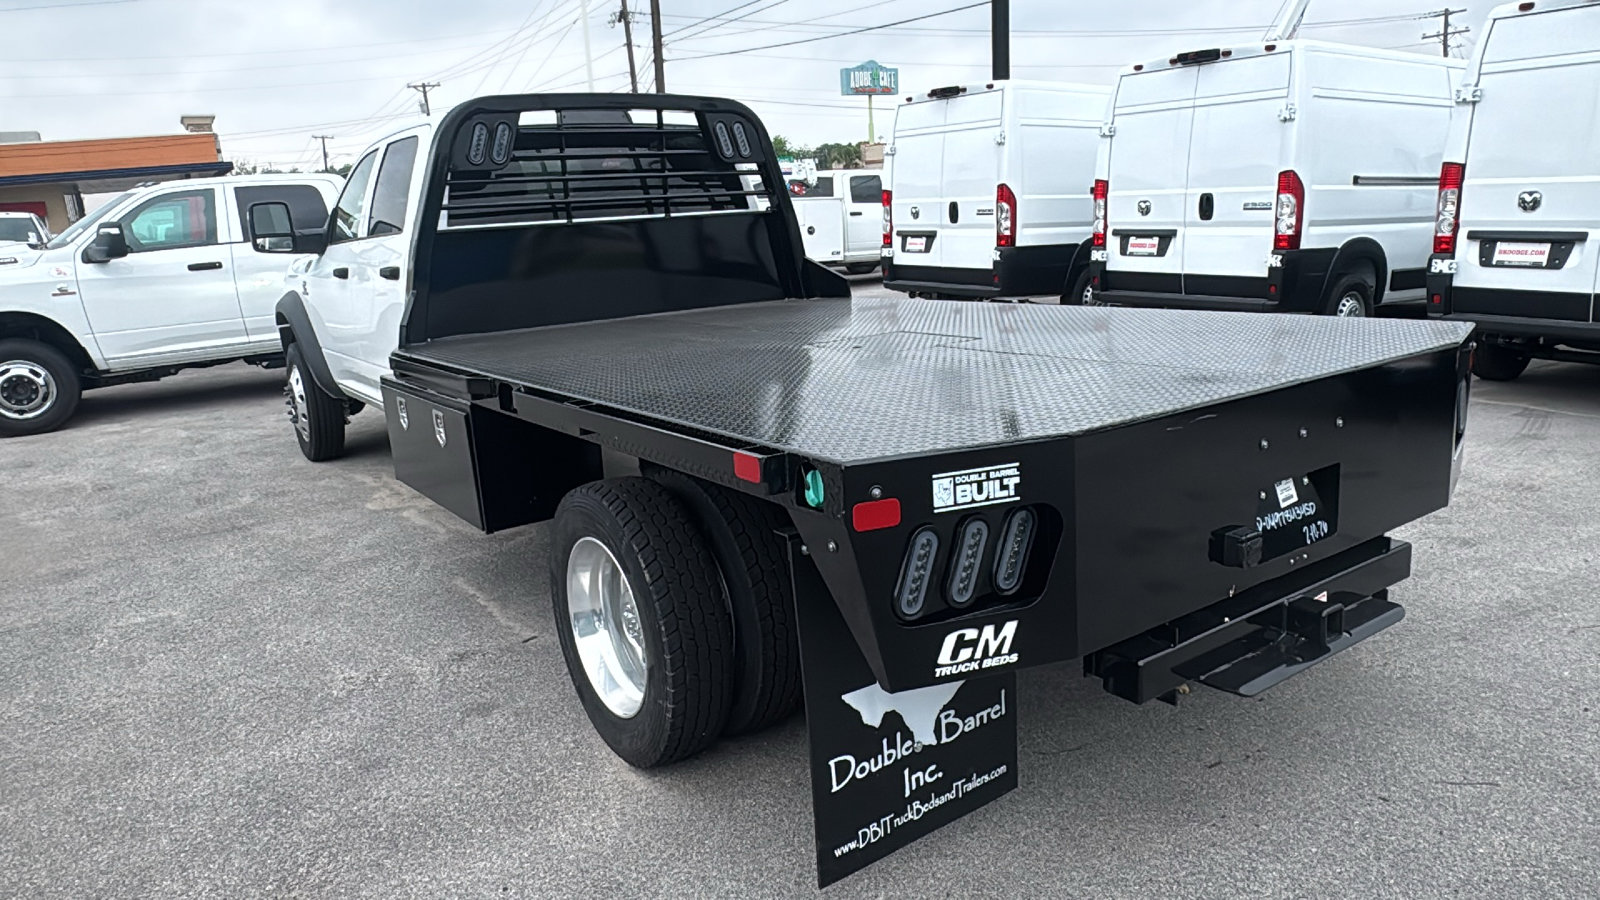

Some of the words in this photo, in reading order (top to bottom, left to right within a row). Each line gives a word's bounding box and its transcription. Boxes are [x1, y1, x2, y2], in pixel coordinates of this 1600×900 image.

[850, 71, 872, 88] ADOBE
[879, 71, 896, 88] CAFE
[955, 473, 987, 484] DOUBLE
[989, 467, 1020, 479] BARREL
[955, 476, 1020, 504] BUILT
[937, 620, 1019, 665] CM
[935, 660, 980, 678] TRUCK
[982, 653, 1019, 669] BEDS
[828, 731, 914, 793] Double
[939, 688, 1007, 744] Barrel
[903, 764, 944, 798] Inc.
[834, 764, 1008, 858] www.DBITruckBedsandTrailers.com
